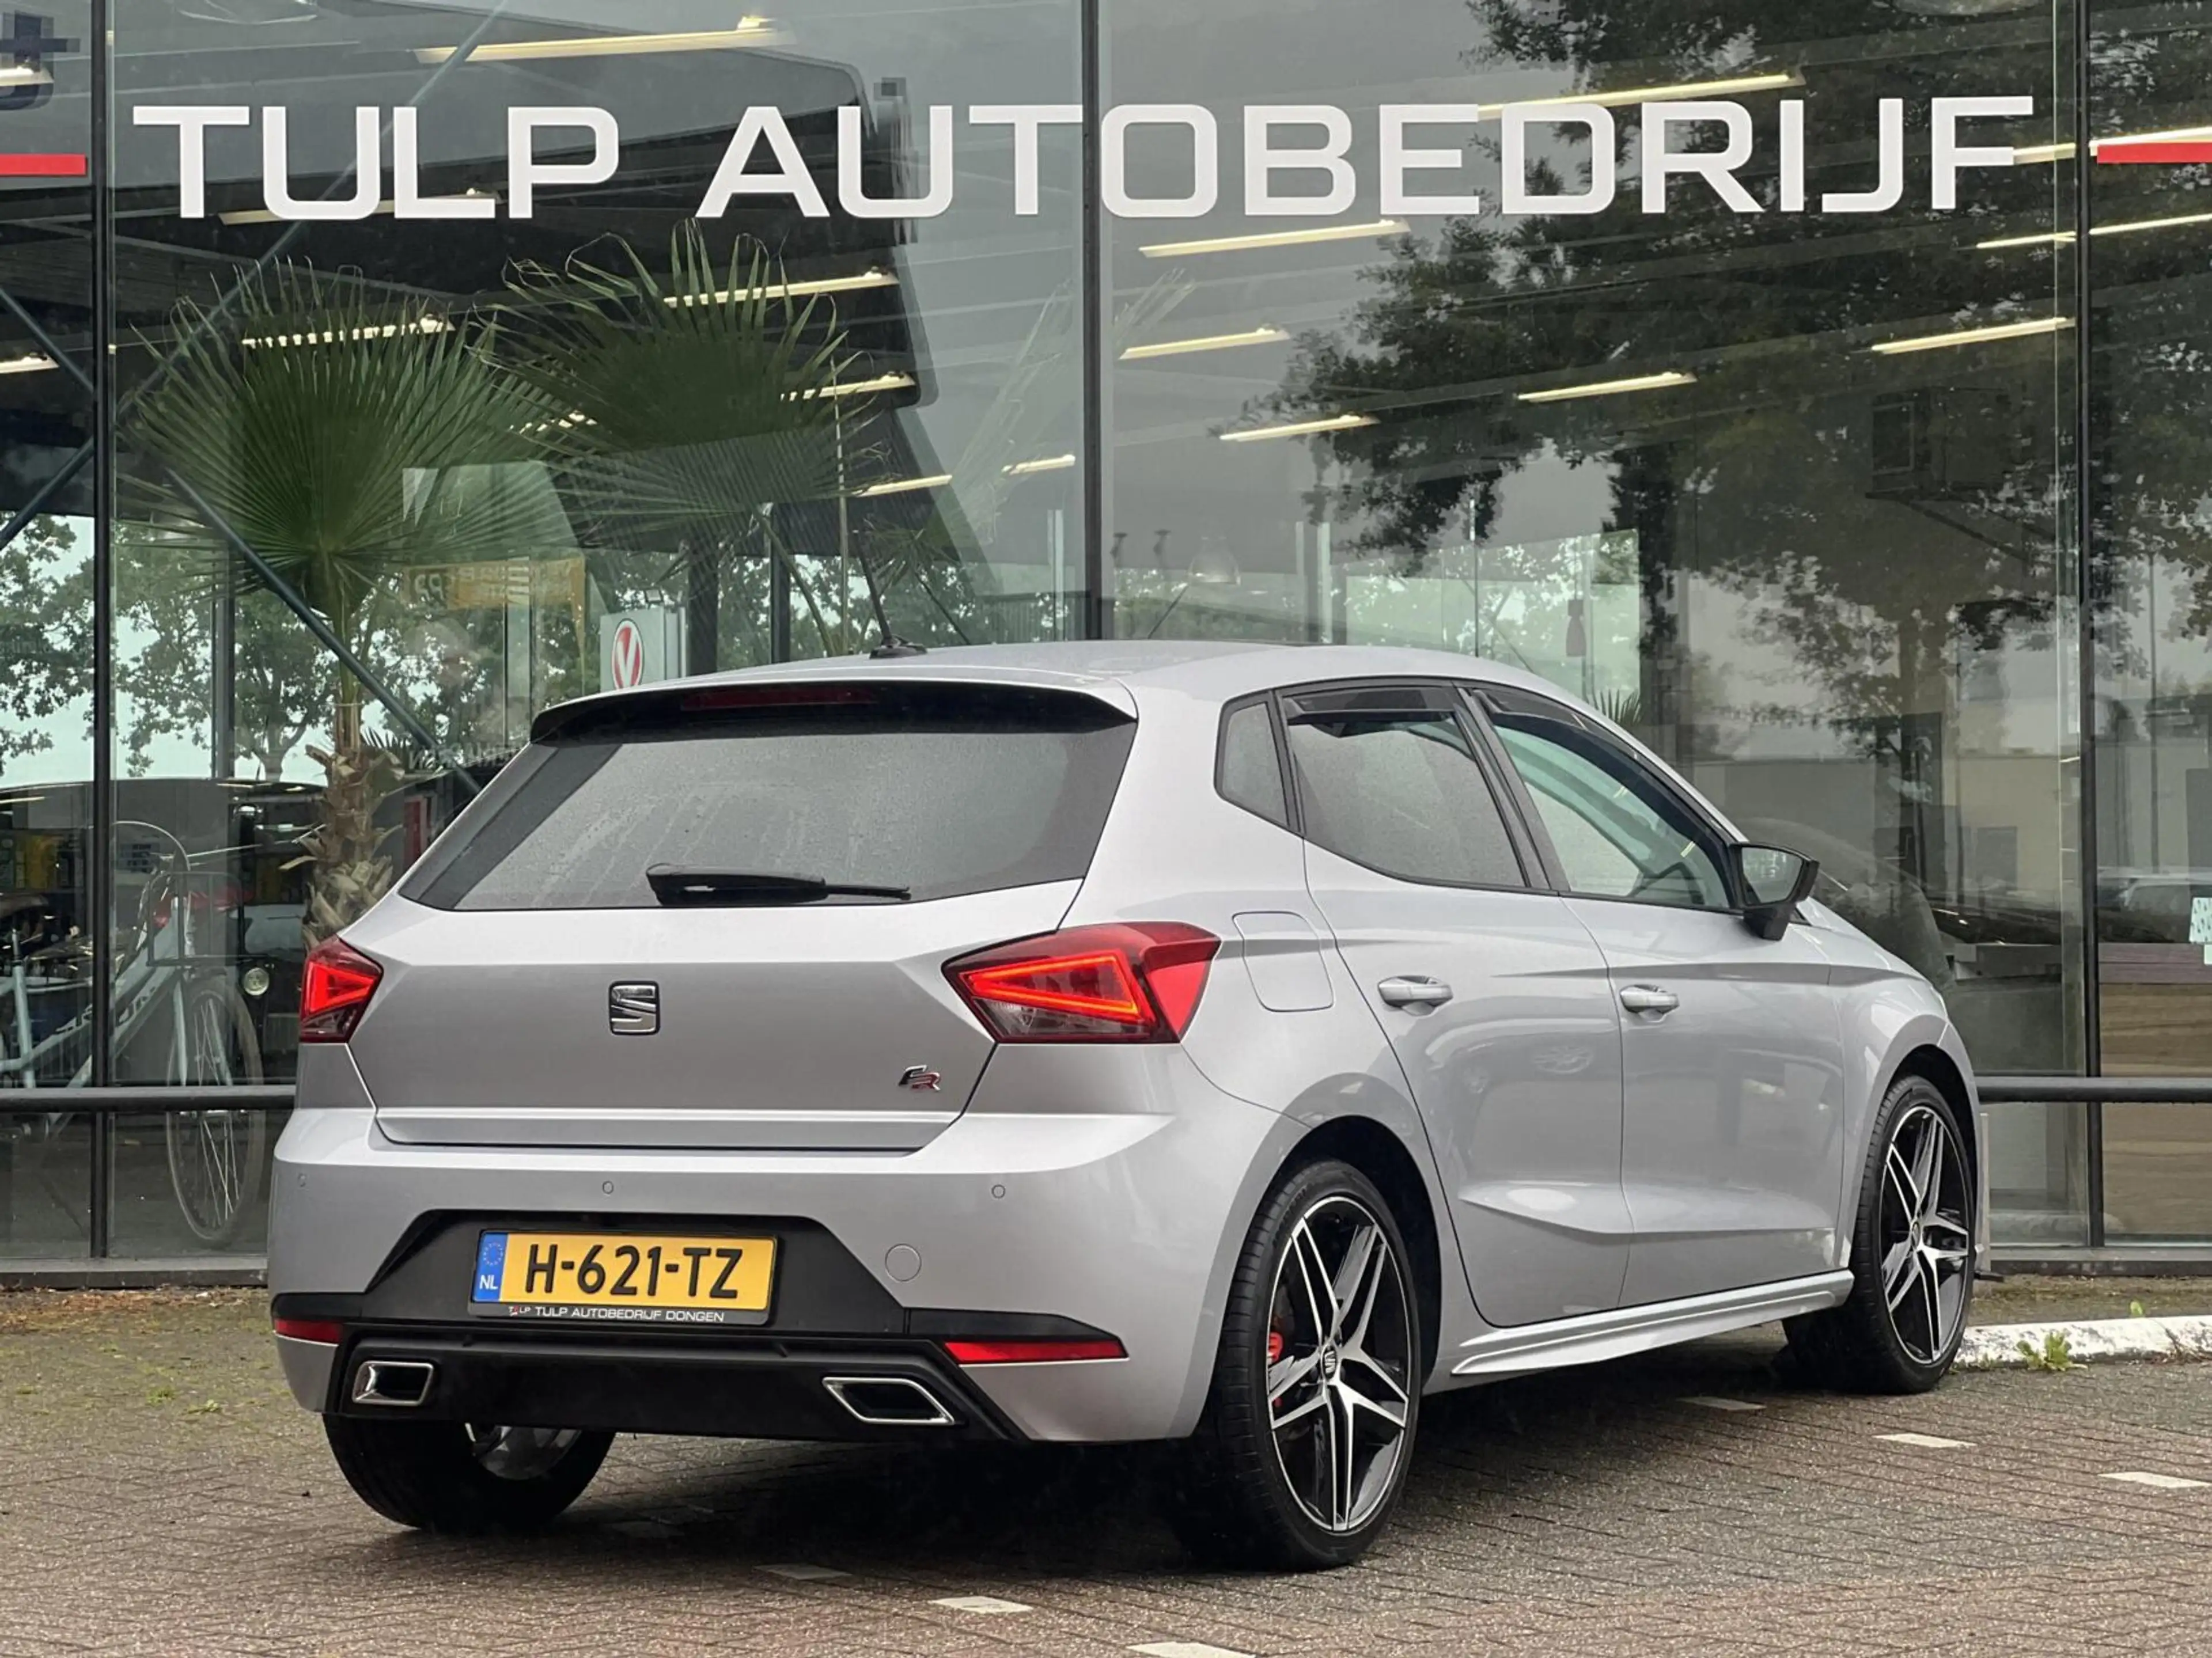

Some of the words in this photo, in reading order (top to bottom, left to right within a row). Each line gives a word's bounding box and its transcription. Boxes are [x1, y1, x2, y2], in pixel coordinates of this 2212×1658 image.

[132, 106, 619, 220] TULP
[695, 96, 2035, 219] AUTOBEDRIJF
[479, 1274, 498, 1290] NL
[525, 1243, 743, 1299] H-621-TZ
[535, 1306, 569, 1317] TULP
[571, 1308, 662, 1321] AUTOBEDRIJF
[665, 1310, 725, 1323] DONGEN
